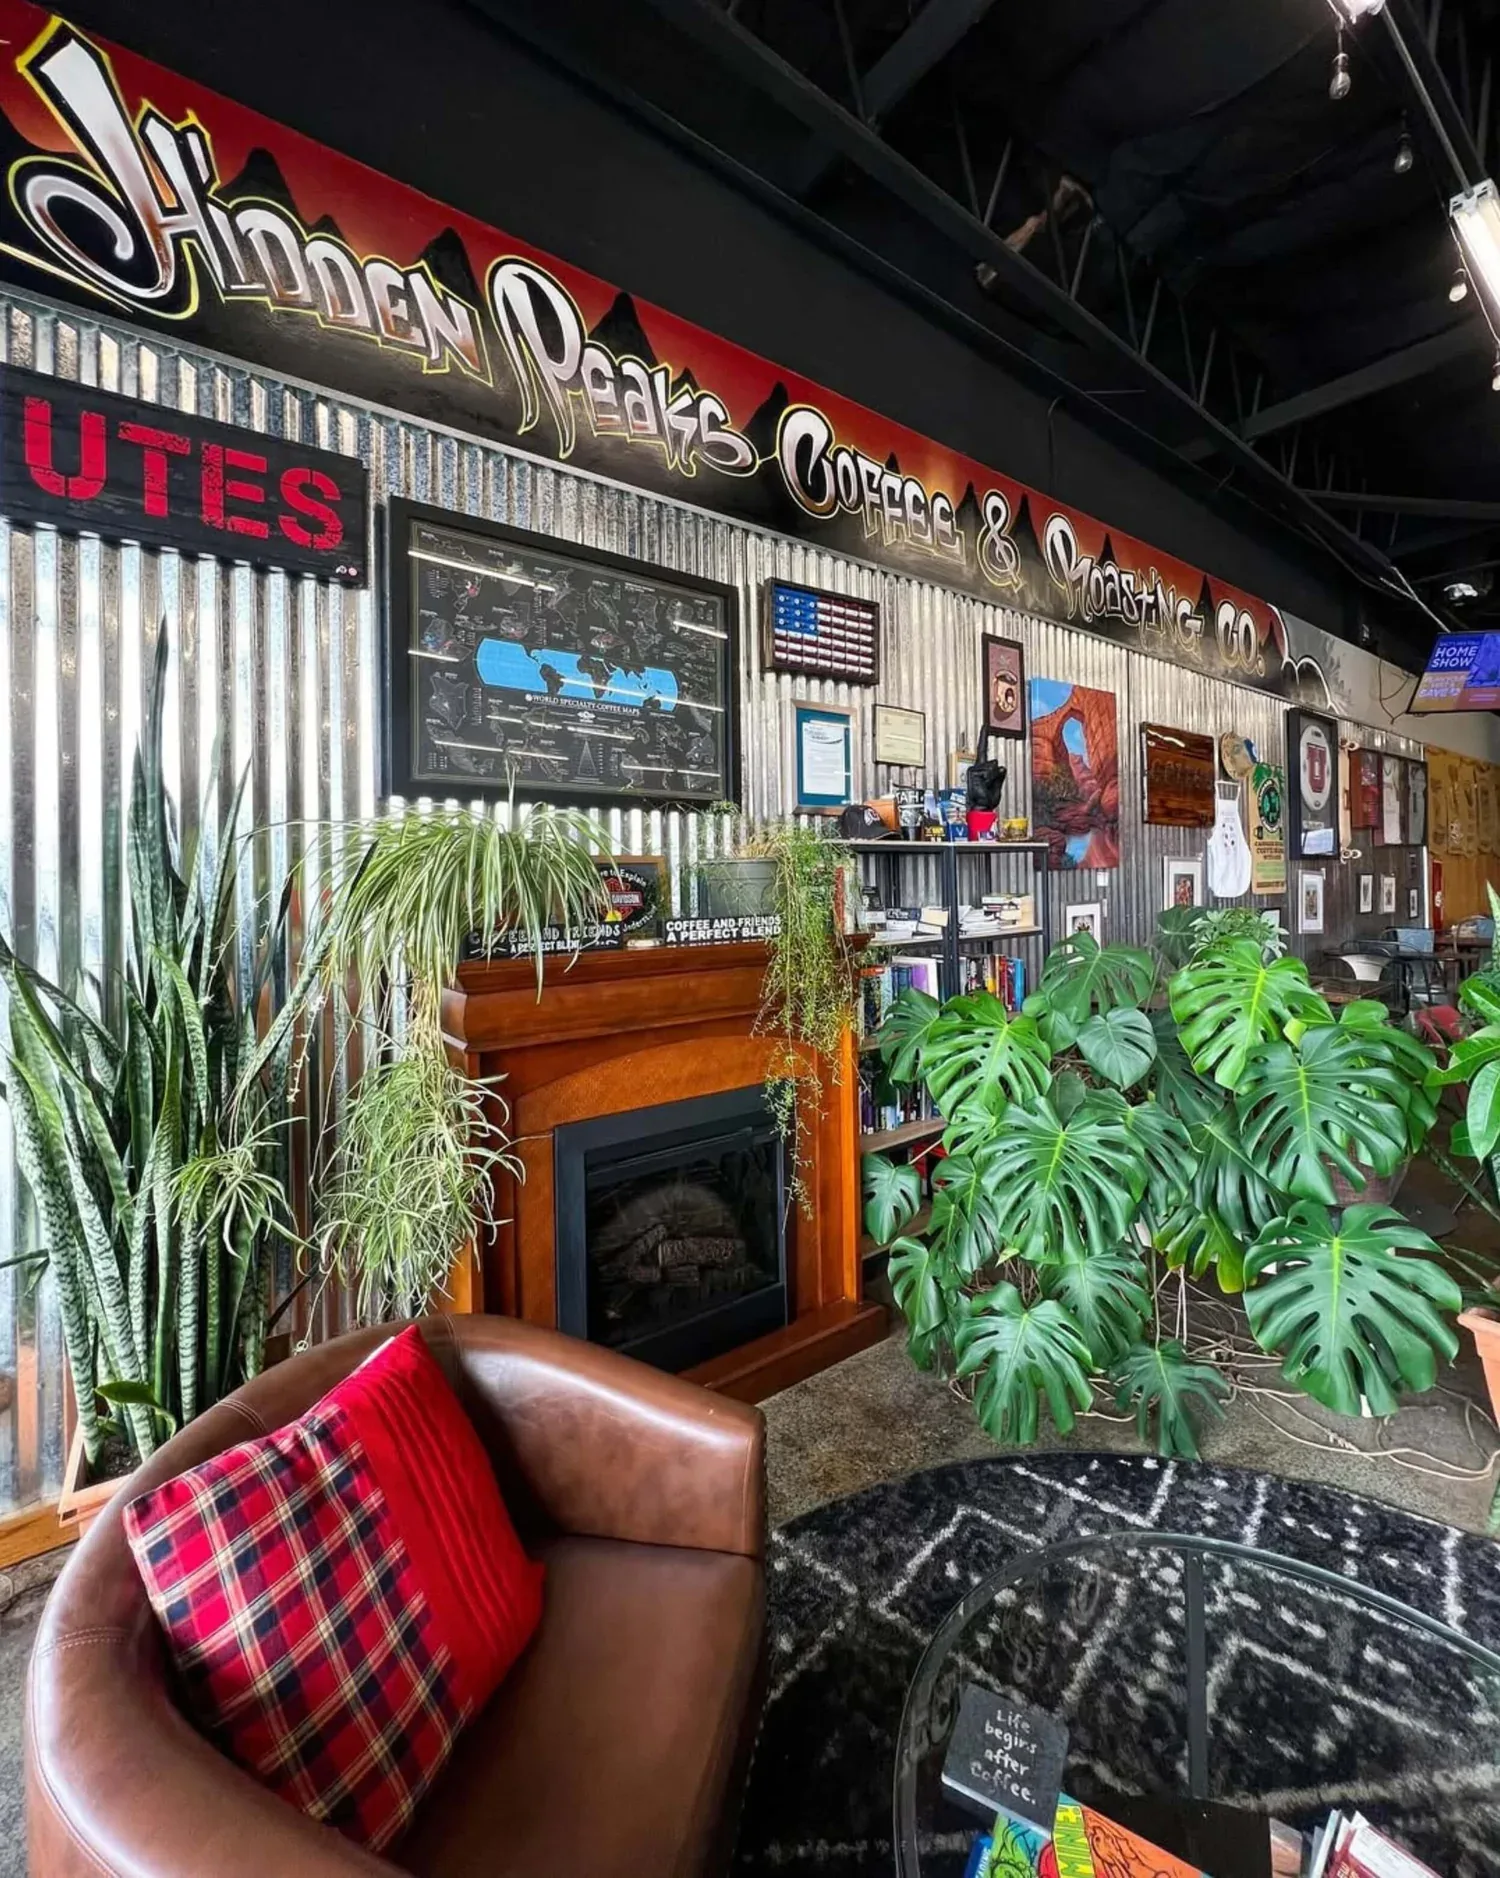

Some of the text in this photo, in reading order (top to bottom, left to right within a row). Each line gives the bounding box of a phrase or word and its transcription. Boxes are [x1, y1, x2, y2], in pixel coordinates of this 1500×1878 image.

[23, 394, 345, 553] UTES
[977, 488, 1024, 594] &
[1435, 646, 1479, 657] HOME
[1431, 657, 1474, 668] SHOW
[532, 694, 559, 704] WORLD
[666, 914, 781, 931] COFFEE AND FRIENDS
[666, 926, 781, 942] A PERFECT BLEND
[510, 944, 517, 954] A
[996, 1709, 1031, 1734] Life
[984, 1719, 1037, 1754] begins
[984, 1748, 1030, 1776] after
